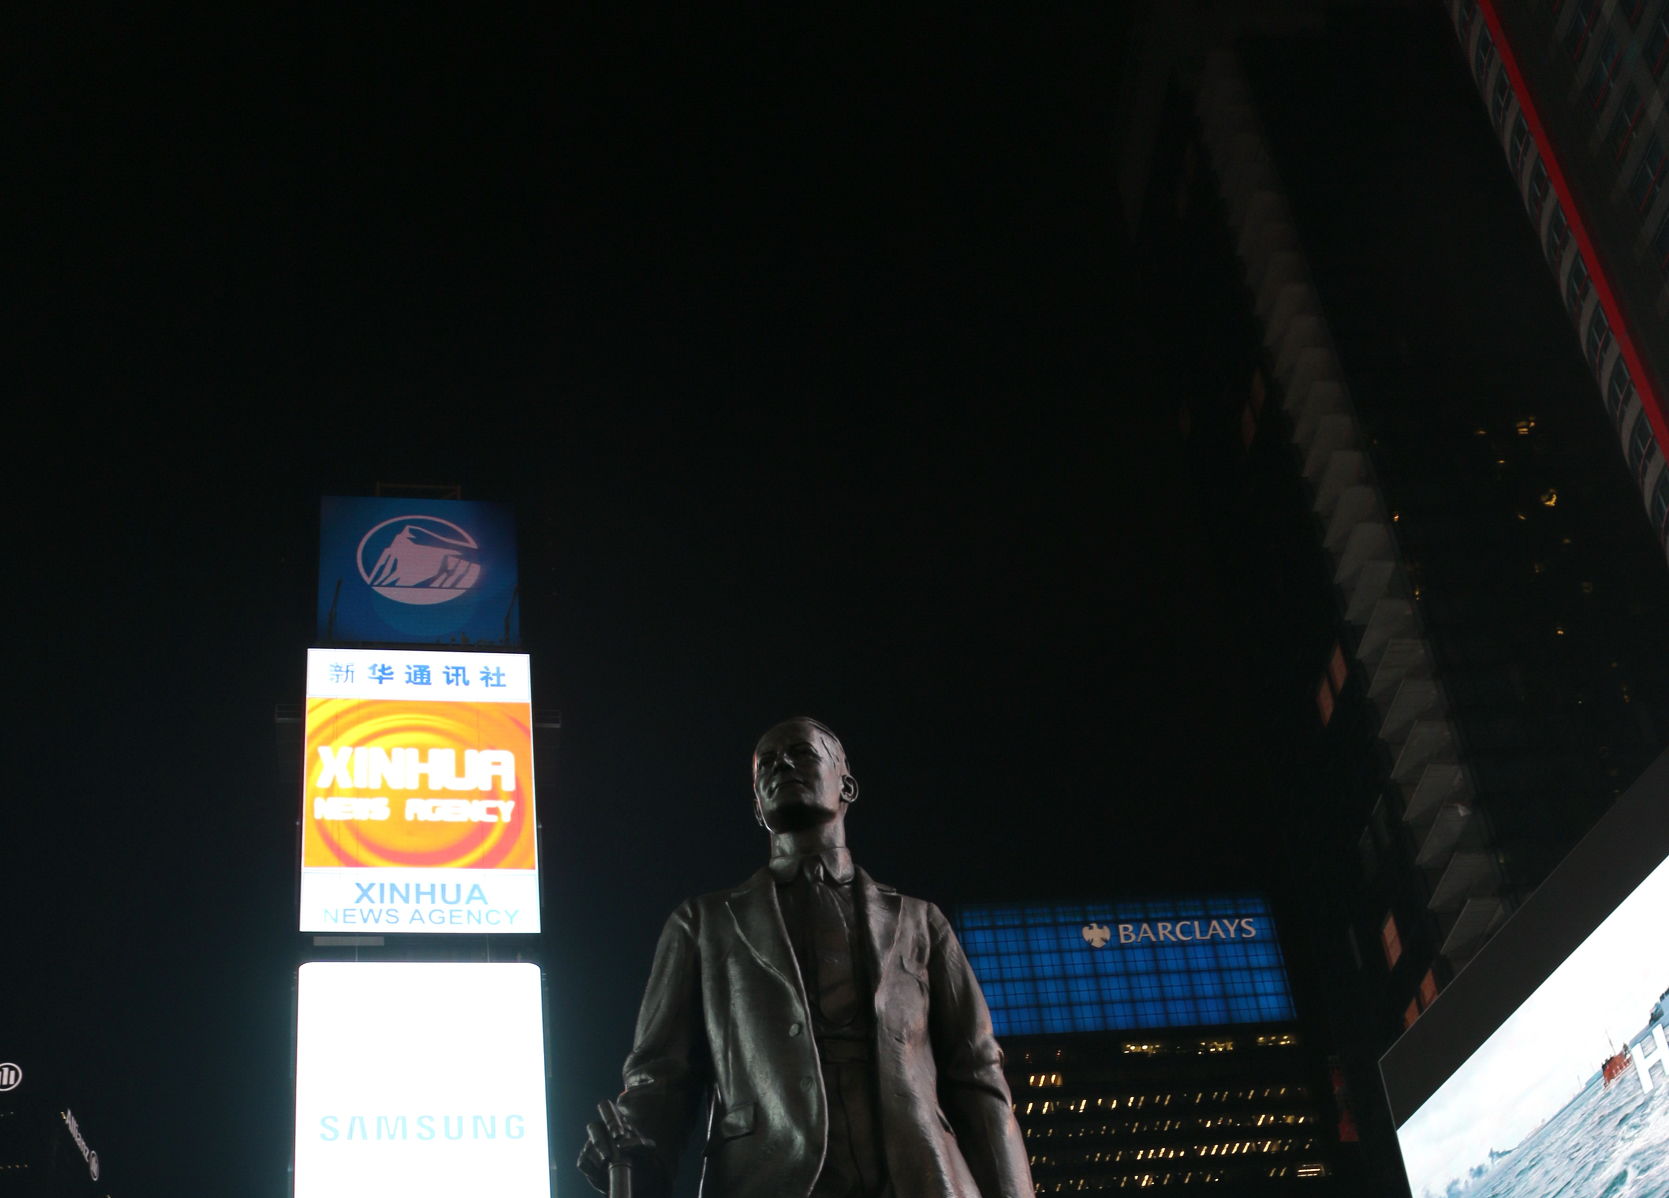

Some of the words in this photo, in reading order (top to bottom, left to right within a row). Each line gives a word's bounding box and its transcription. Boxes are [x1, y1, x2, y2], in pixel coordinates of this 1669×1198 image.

[328, 661, 507, 688] 新华通讯社
[315, 746, 516, 792] XINHUA
[354, 882, 489, 905] XINHUA
[323, 907, 401, 926] NEWS
[409, 908, 521, 927] AGENCY
[1118, 918, 1257, 944] BARCLAYS
[319, 1114, 526, 1142] SAMSUNG
